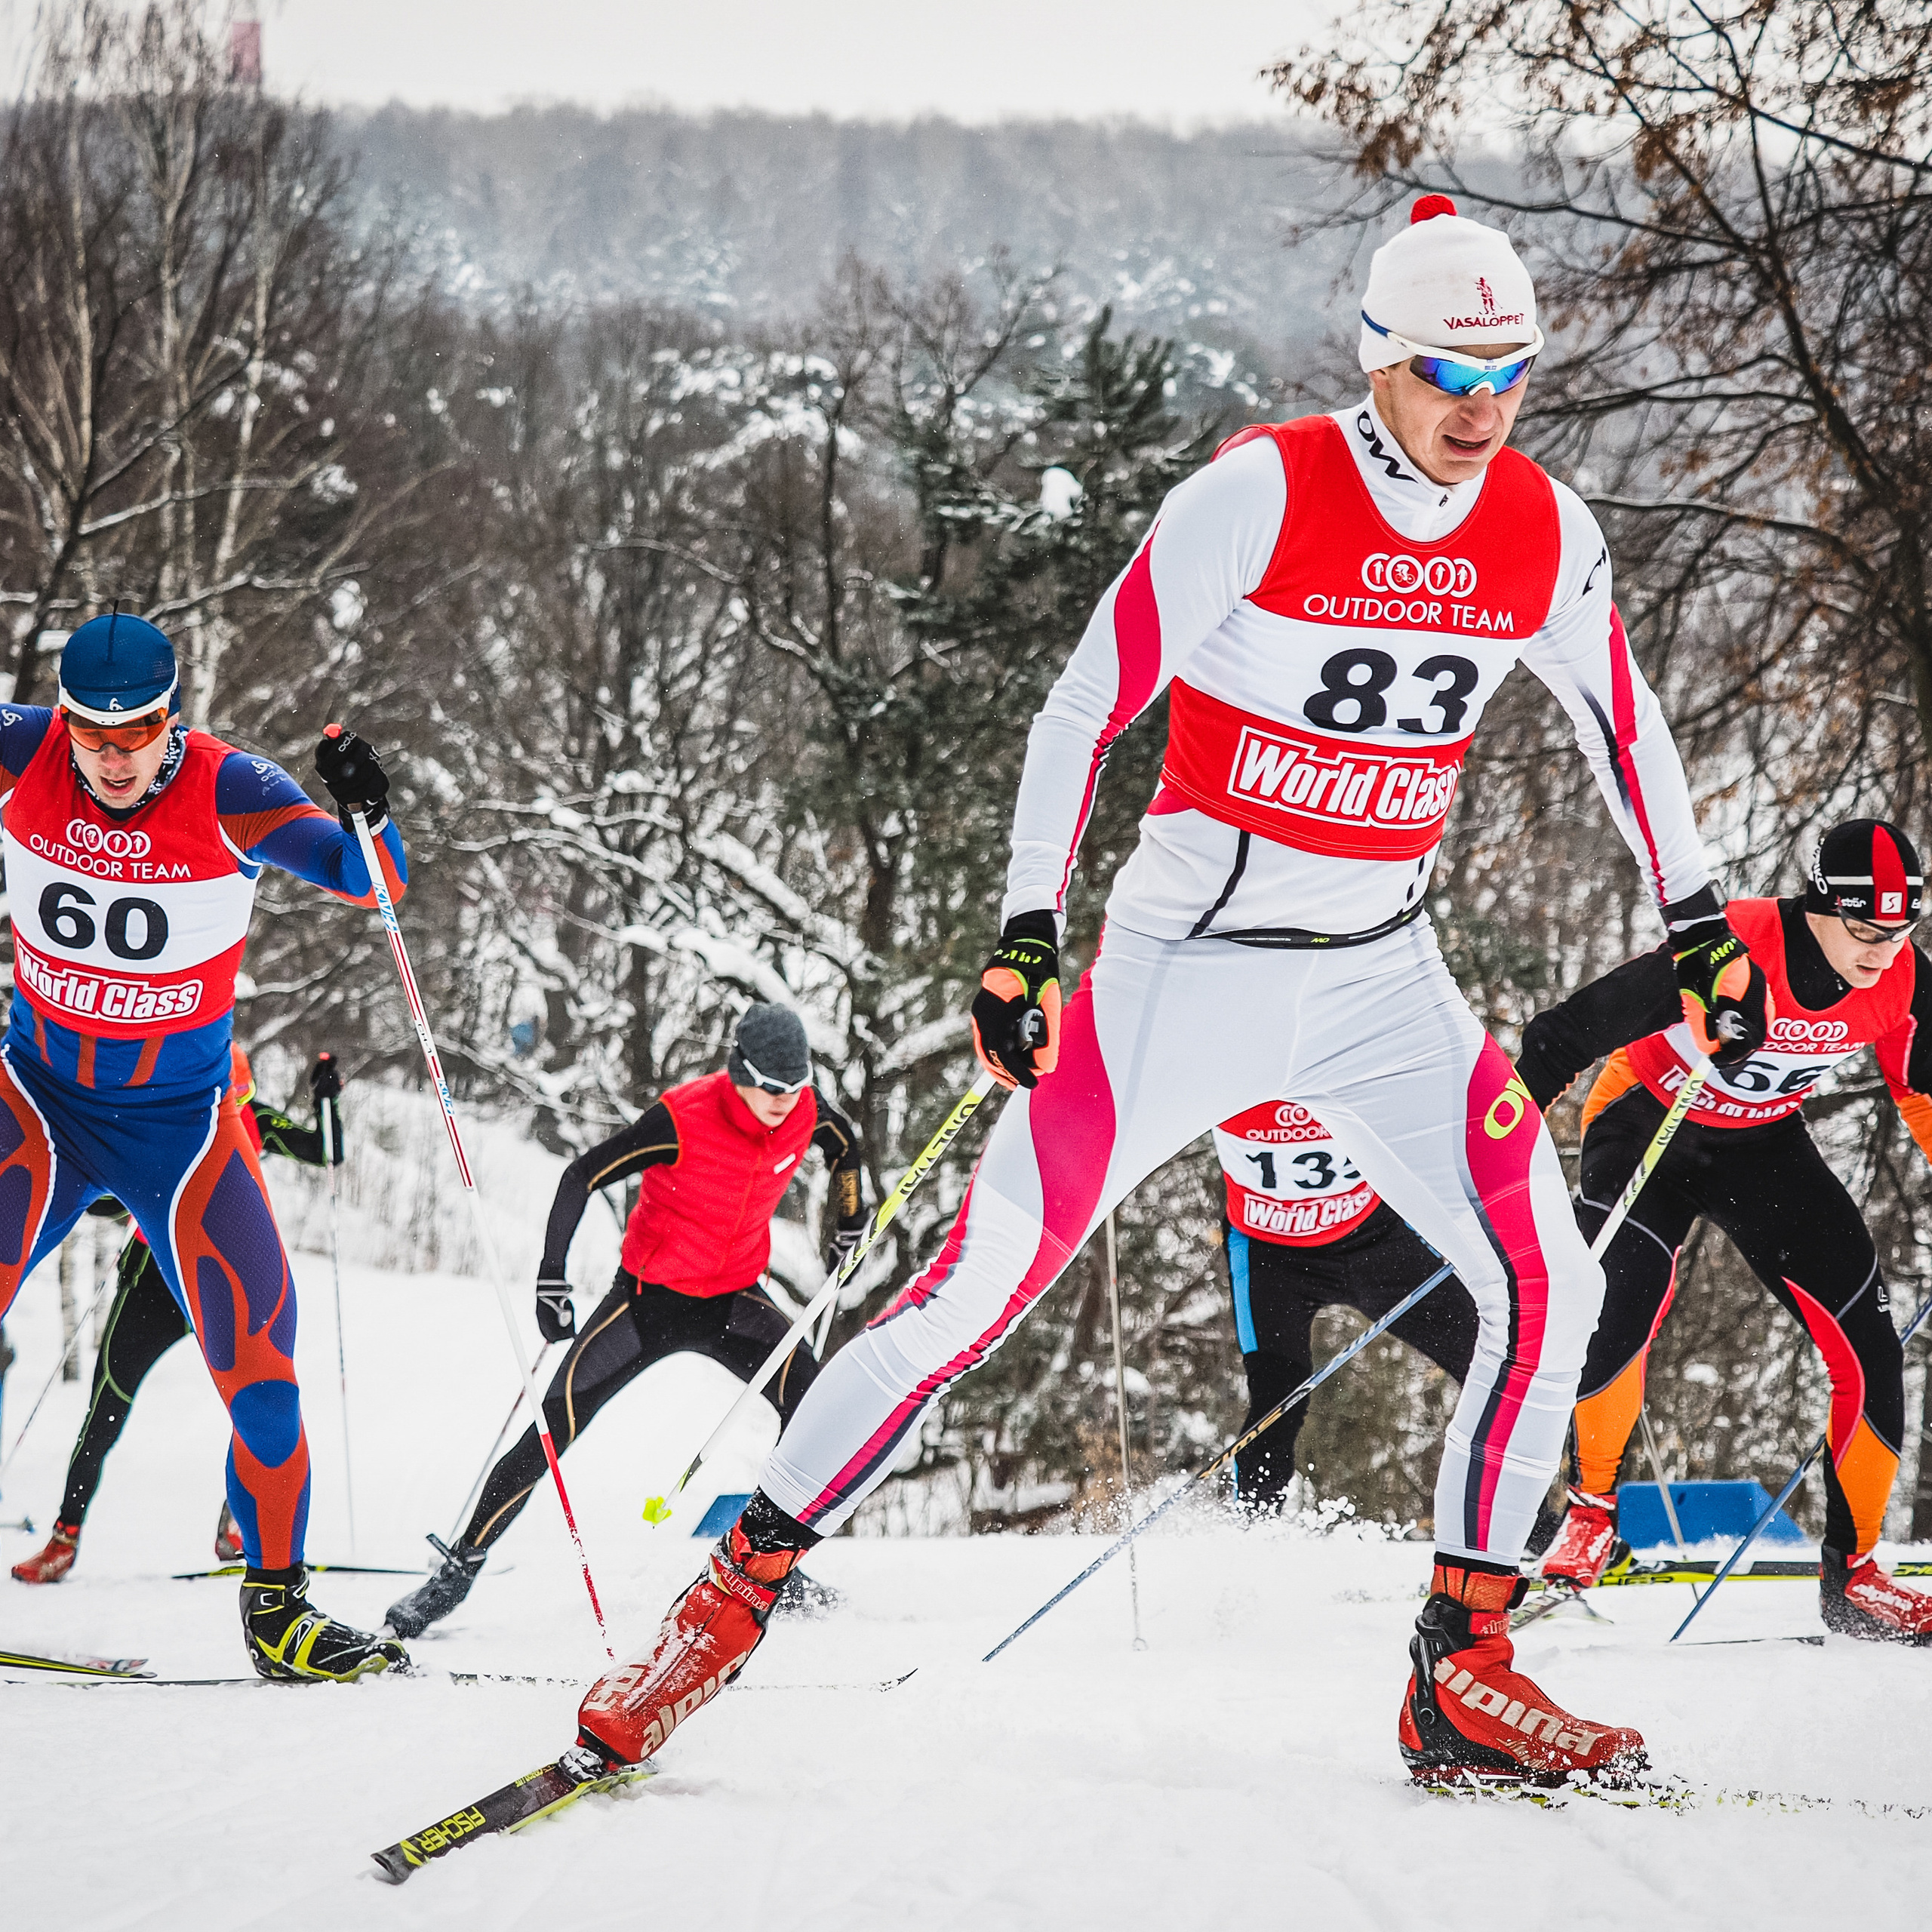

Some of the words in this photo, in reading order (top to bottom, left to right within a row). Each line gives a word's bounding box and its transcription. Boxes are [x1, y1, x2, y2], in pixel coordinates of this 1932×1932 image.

[1443, 313, 1524, 330] VASALOPPET
[1303, 593, 1441, 626] OUTDOOR
[1452, 605, 1514, 632] TEAM
[1303, 648, 1479, 734] 83
[1237, 739, 1377, 817] World
[29, 833, 123, 878] OUTDOOR
[130, 863, 192, 879] TEAM
[38, 881, 168, 960] 60
[19, 945, 100, 1011] World
[101, 980, 197, 1019] Class
[1762, 1041, 1817, 1053] DOOR
[1820, 1041, 1866, 1053] TEAM
[1714, 1060, 1832, 1094] 66
[1248, 1200, 1318, 1233] World
[721, 1568, 770, 1612] alpina
[1433, 1657, 1600, 1757] alpina
[414, 1805, 487, 1853] FISCHER
